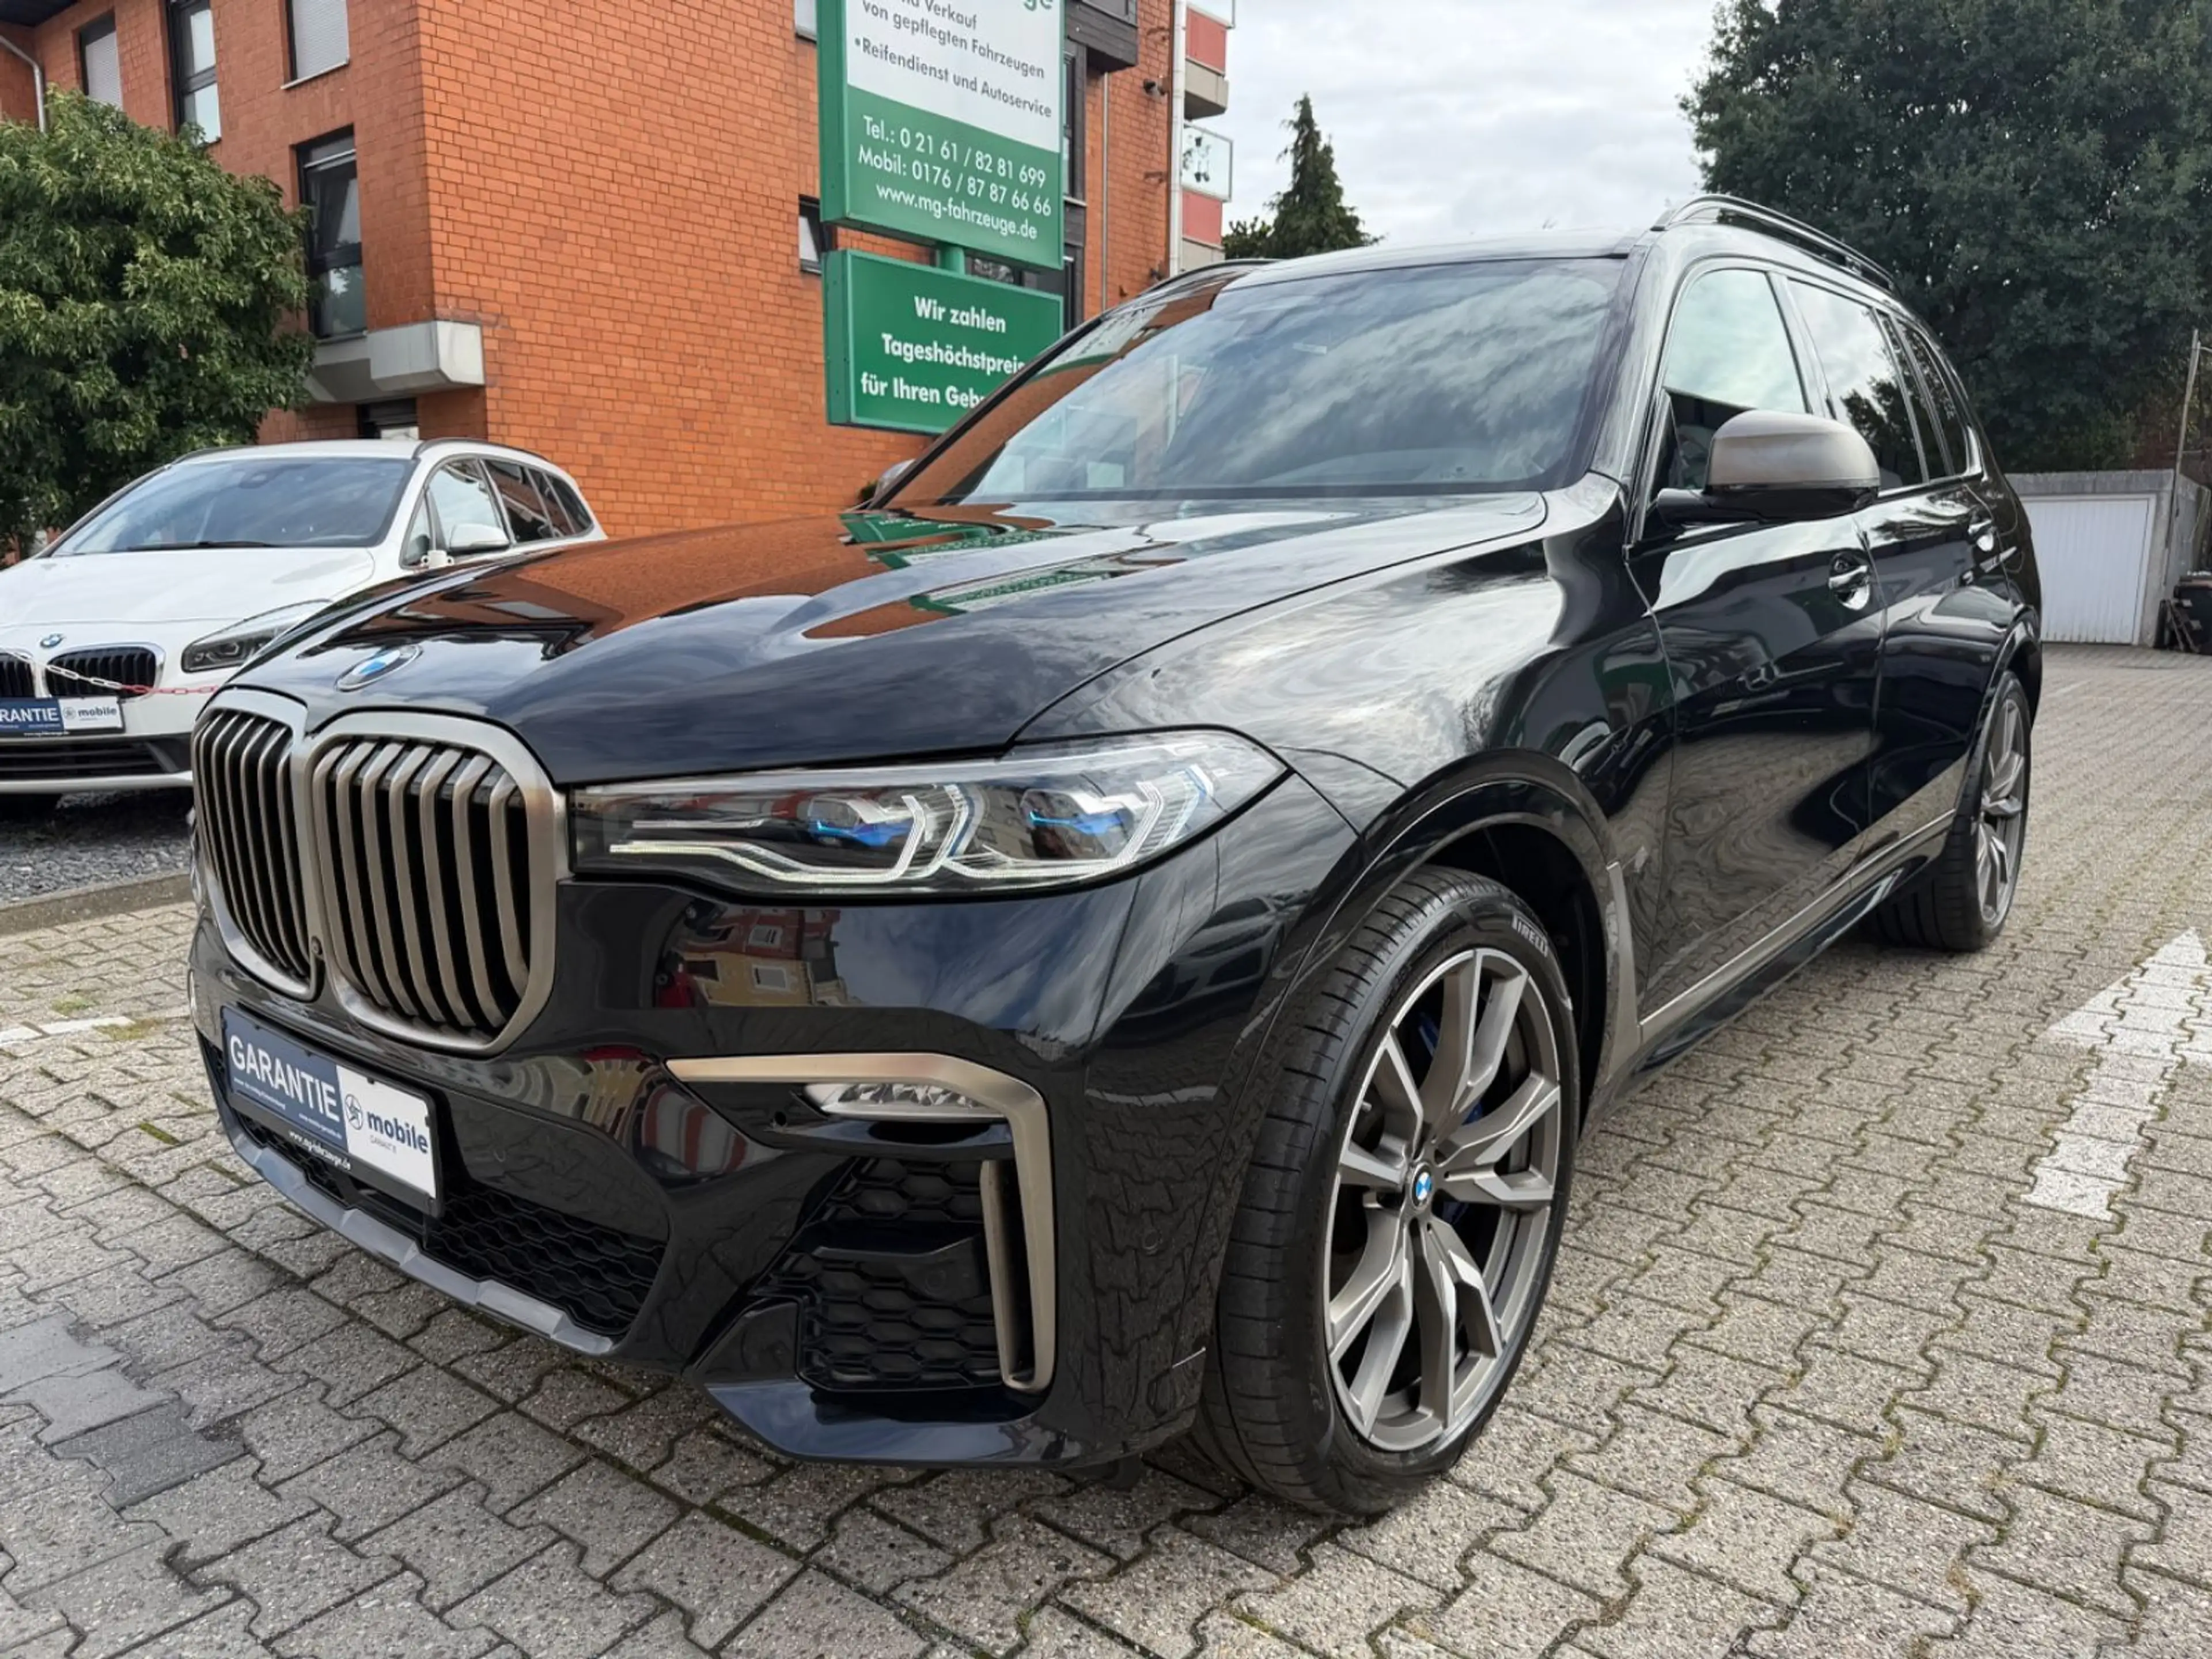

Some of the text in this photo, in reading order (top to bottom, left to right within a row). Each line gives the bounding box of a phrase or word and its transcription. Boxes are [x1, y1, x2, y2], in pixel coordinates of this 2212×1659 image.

[925, 0, 977, 29] Verkauf
[863, 2, 1044, 78] von gepflegten Fahrzeugen
[953, 74, 977, 92] und
[981, 82, 1052, 118] Autoservice
[863, 115, 1046, 189] Tel.: 0 21 61 / 82 81 699
[858, 144, 1052, 217] Mobil: 0176 / 87 87 66 66
[876, 184, 1037, 239] www.mg-fahrzeuge.de
[914, 296, 1006, 333] Wir zahlen
[861, 372, 986, 408] für Ihren Geb
[78, 706, 118, 717] mobile
[1512, 913, 1550, 958] PIRELLI
[230, 1035, 340, 1123] GARANTIE
[367, 1111, 428, 1154] mobile
